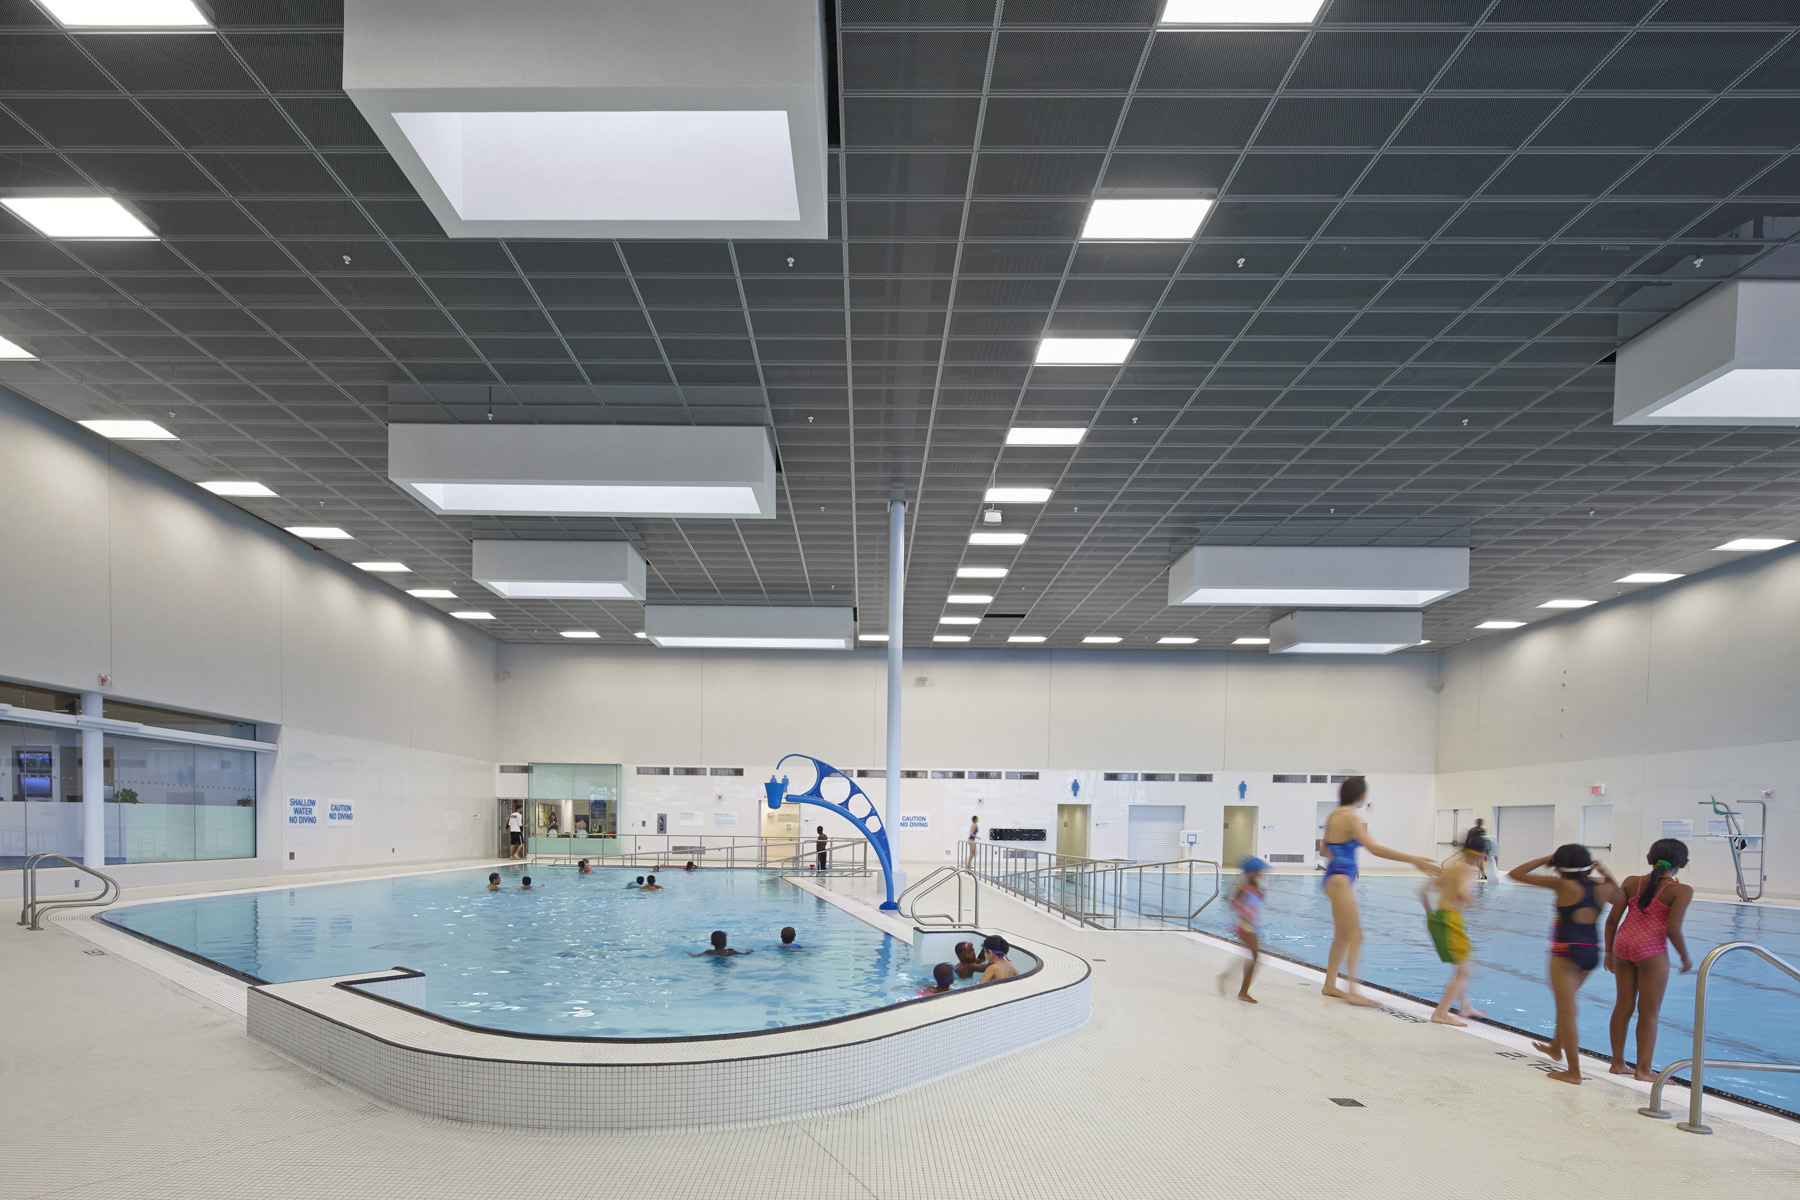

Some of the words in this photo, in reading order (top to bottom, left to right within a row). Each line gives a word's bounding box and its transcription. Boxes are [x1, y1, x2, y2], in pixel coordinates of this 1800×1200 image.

[289, 798, 316, 806] SHALLOW
[293, 807, 313, 815] WATER
[330, 804, 352, 812] CAUTION
[289, 816, 298, 824] NO
[298, 816, 317, 824] DIVING
[329, 812, 337, 820] NO
[337, 812, 353, 820] DIVING
